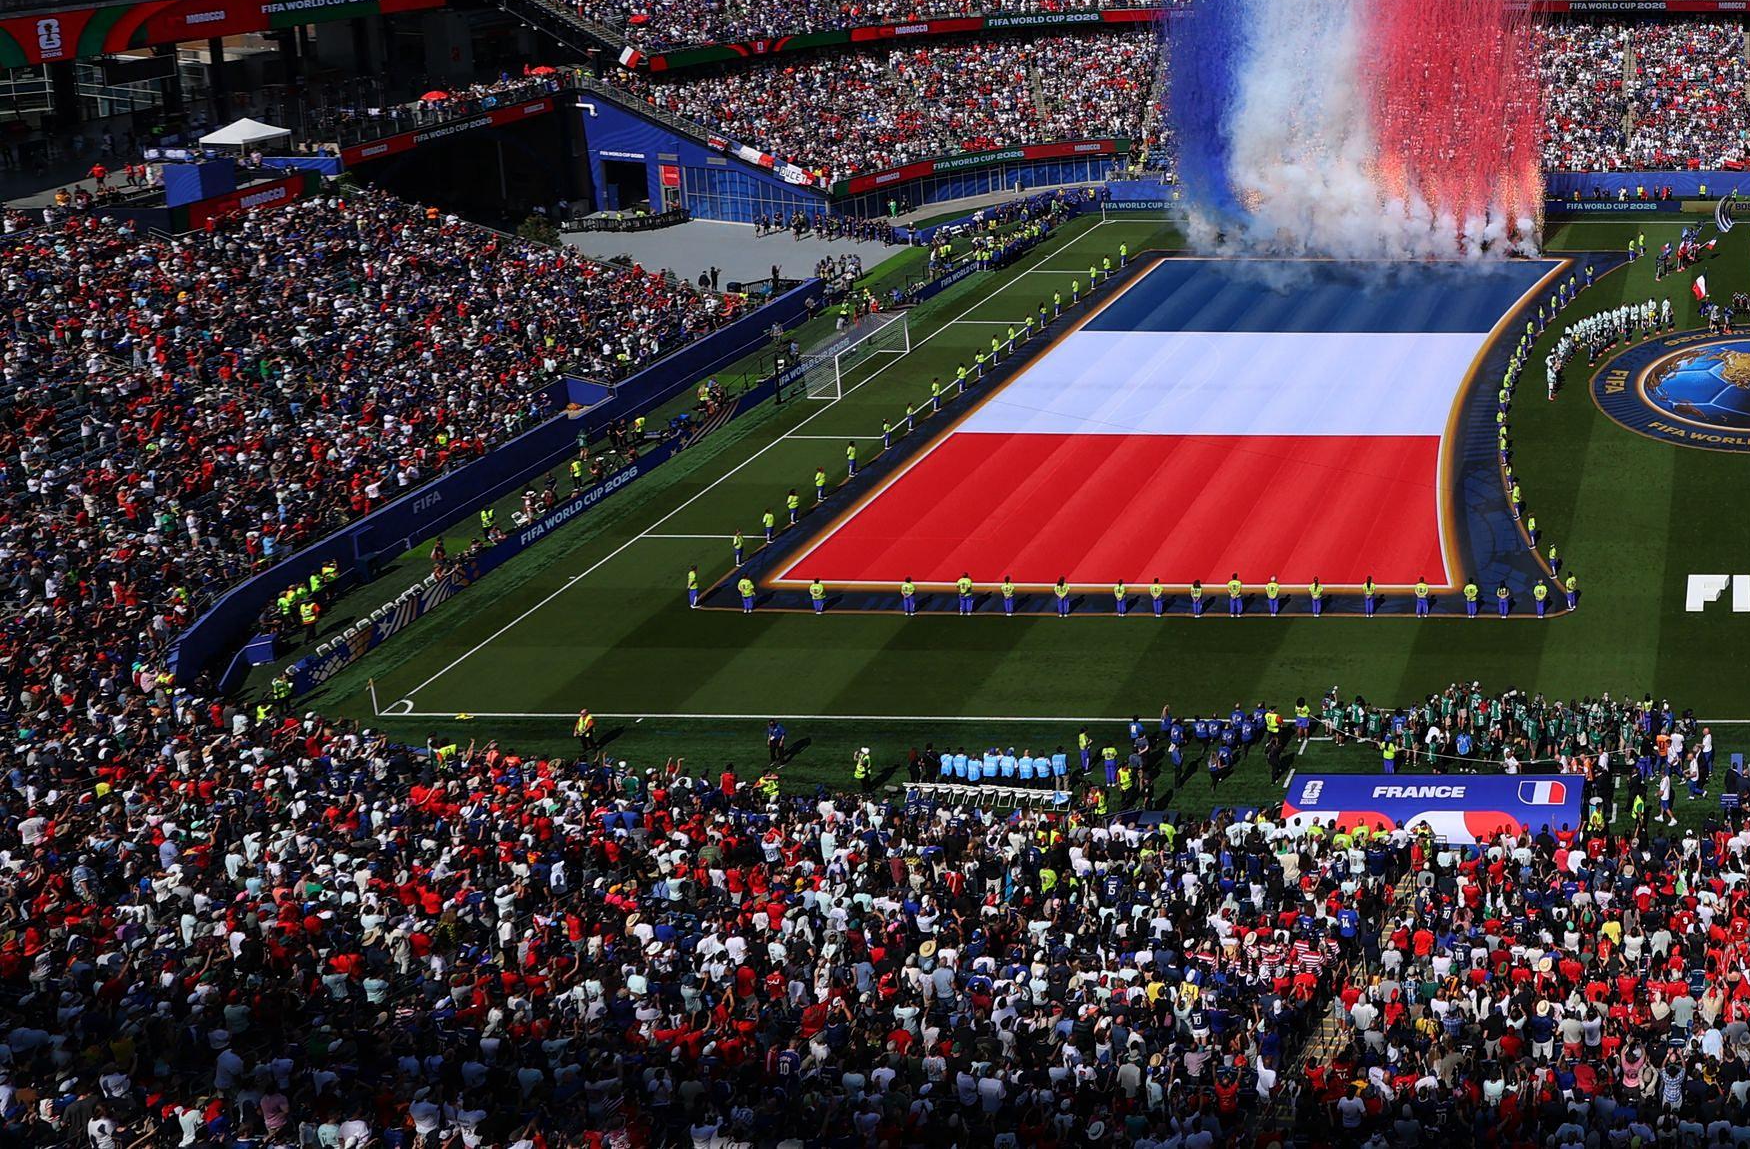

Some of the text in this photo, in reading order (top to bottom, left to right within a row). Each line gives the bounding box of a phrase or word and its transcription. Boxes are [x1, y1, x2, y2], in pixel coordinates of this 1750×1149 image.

[261, 3, 285, 13] FIFA
[1569, 2, 1666, 10] FIFA WORLD CUP 2026
[186, 10, 226, 25] MOROCCO
[988, 13, 1099, 27] FIFA WORLD CUP 2026
[895, 25, 928, 35] MOROCCO
[413, 123, 469, 143] FIFA WORLD CUP
[933, 151, 1024, 170] FIFA WORLD CUP 2026
[876, 172, 900, 183] MOROCCO
[240, 187, 286, 209] MOROCCO
[1605, 369, 1629, 394] FIFA
[1648, 421, 1686, 437] FIFA
[412, 491, 442, 514] FIFA
[521, 466, 638, 545] FIFA WORLD CUP 2026
[1372, 786, 1466, 798] FRANCE
[1108, 885, 1116, 895] 15
[1341, 918, 1350, 928] 14
[1455, 952, 1464, 961] 10
[780, 1062, 789, 1075] 10
